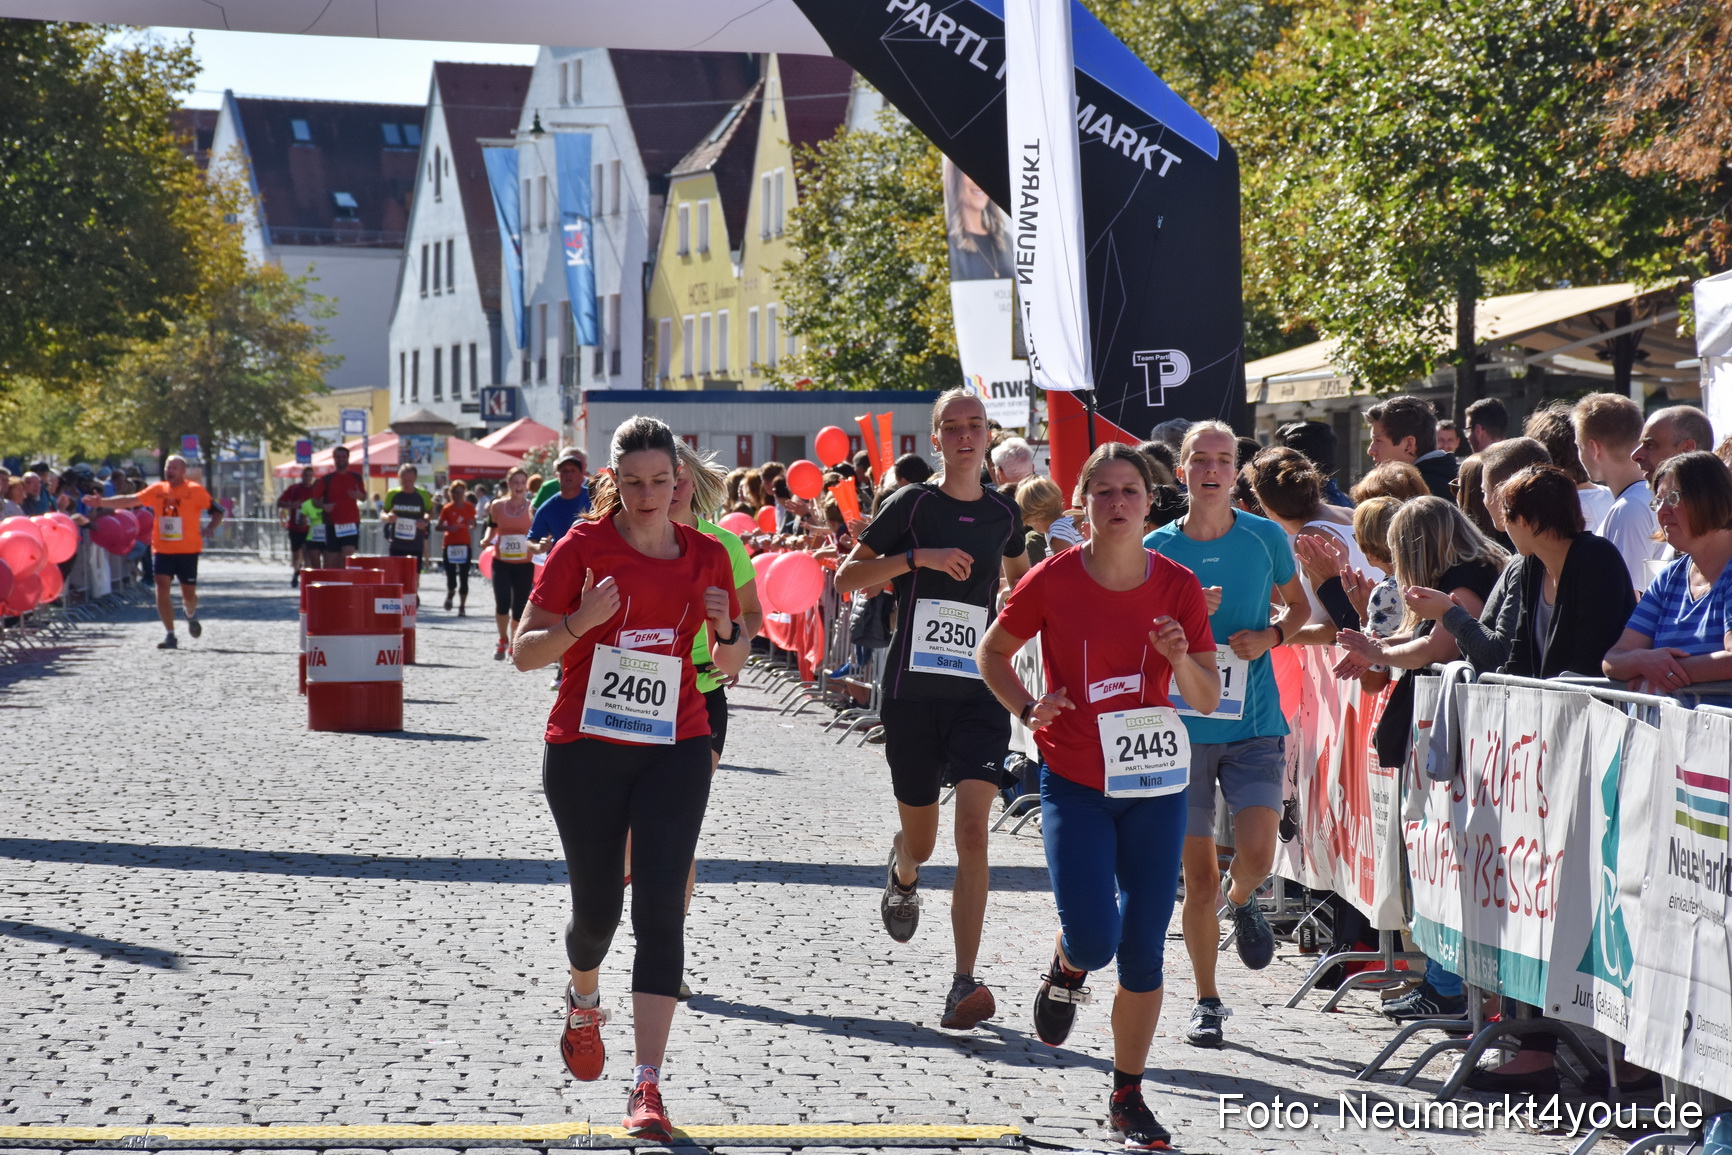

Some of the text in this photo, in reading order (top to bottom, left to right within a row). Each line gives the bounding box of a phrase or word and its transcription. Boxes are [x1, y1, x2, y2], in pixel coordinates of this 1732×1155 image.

[505, 542, 521, 551] 203
[938, 606, 970, 620] BOCK
[634, 632, 660, 643] DEHN
[925, 620, 976, 649] 2350
[946, 647, 967, 655] Neumarkt
[619, 656, 659, 671] BOCK
[936, 656, 963, 669] Sarah
[601, 671, 666, 707] 2460
[1103, 681, 1126, 694] DEHN
[604, 702, 651, 715] PARTL Neumarkt
[604, 714, 653, 733] Christina
[1125, 714, 1163, 728] BOCK
[1116, 730, 1178, 763] 2443
[1125, 761, 1169, 772] PARTL Neumarkt
[1139, 775, 1163, 787] Nina
